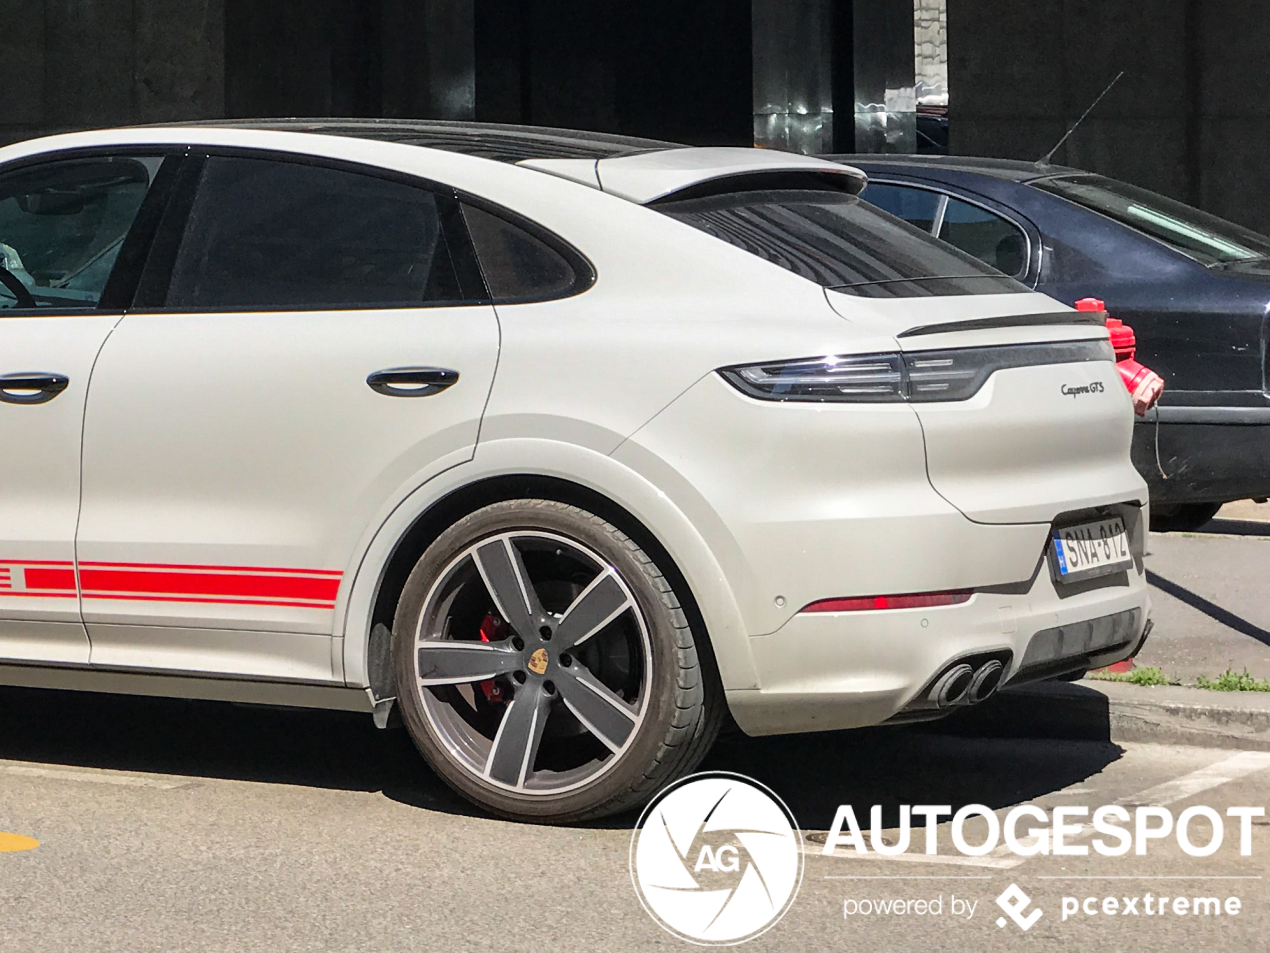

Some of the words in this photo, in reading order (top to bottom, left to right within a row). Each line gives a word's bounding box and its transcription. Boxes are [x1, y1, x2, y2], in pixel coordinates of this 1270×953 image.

[1061, 383, 1090, 399] Cayenne
[1089, 381, 1105, 394] GTS
[1065, 522, 1128, 568] SNA-812
